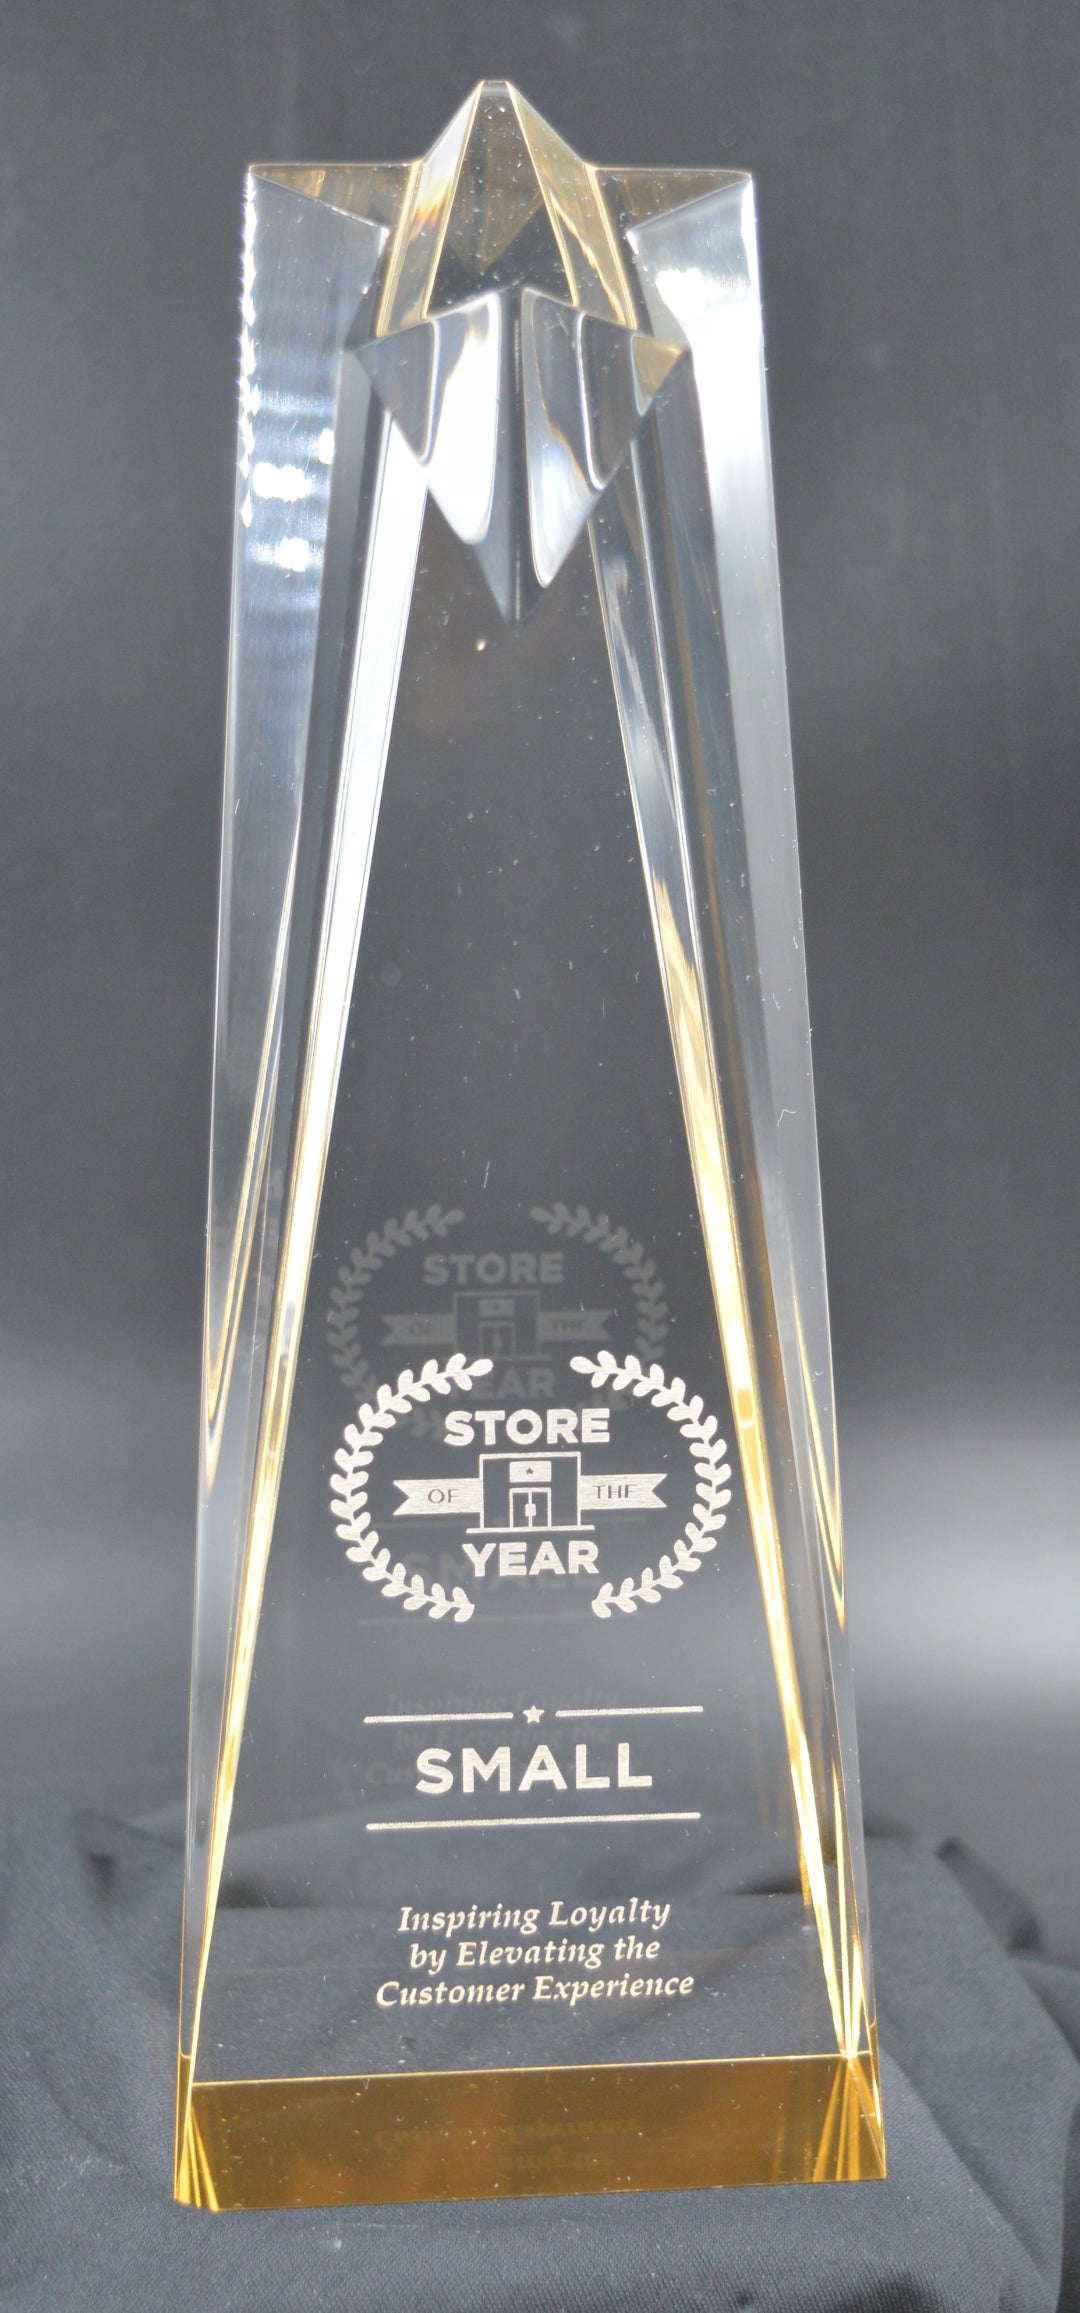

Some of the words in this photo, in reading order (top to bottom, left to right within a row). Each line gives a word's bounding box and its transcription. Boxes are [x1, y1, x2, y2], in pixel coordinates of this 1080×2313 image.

[422, 1251, 566, 1286] STORE
[443, 1407, 611, 1447] STORE
[427, 1488, 460, 1505] OF
[592, 1483, 639, 1500] THE
[461, 1540, 600, 1578] YEAR
[415, 1742, 653, 1795] SMALL
[397, 1902, 541, 1938] Inspiring
[548, 1896, 671, 1931] Loyalty
[409, 1942, 448, 1975] by
[455, 1937, 605, 1969] Elevating
[613, 1935, 662, 1962] the
[376, 1979, 526, 2007] Customer
[532, 1972, 696, 2007] Experience
